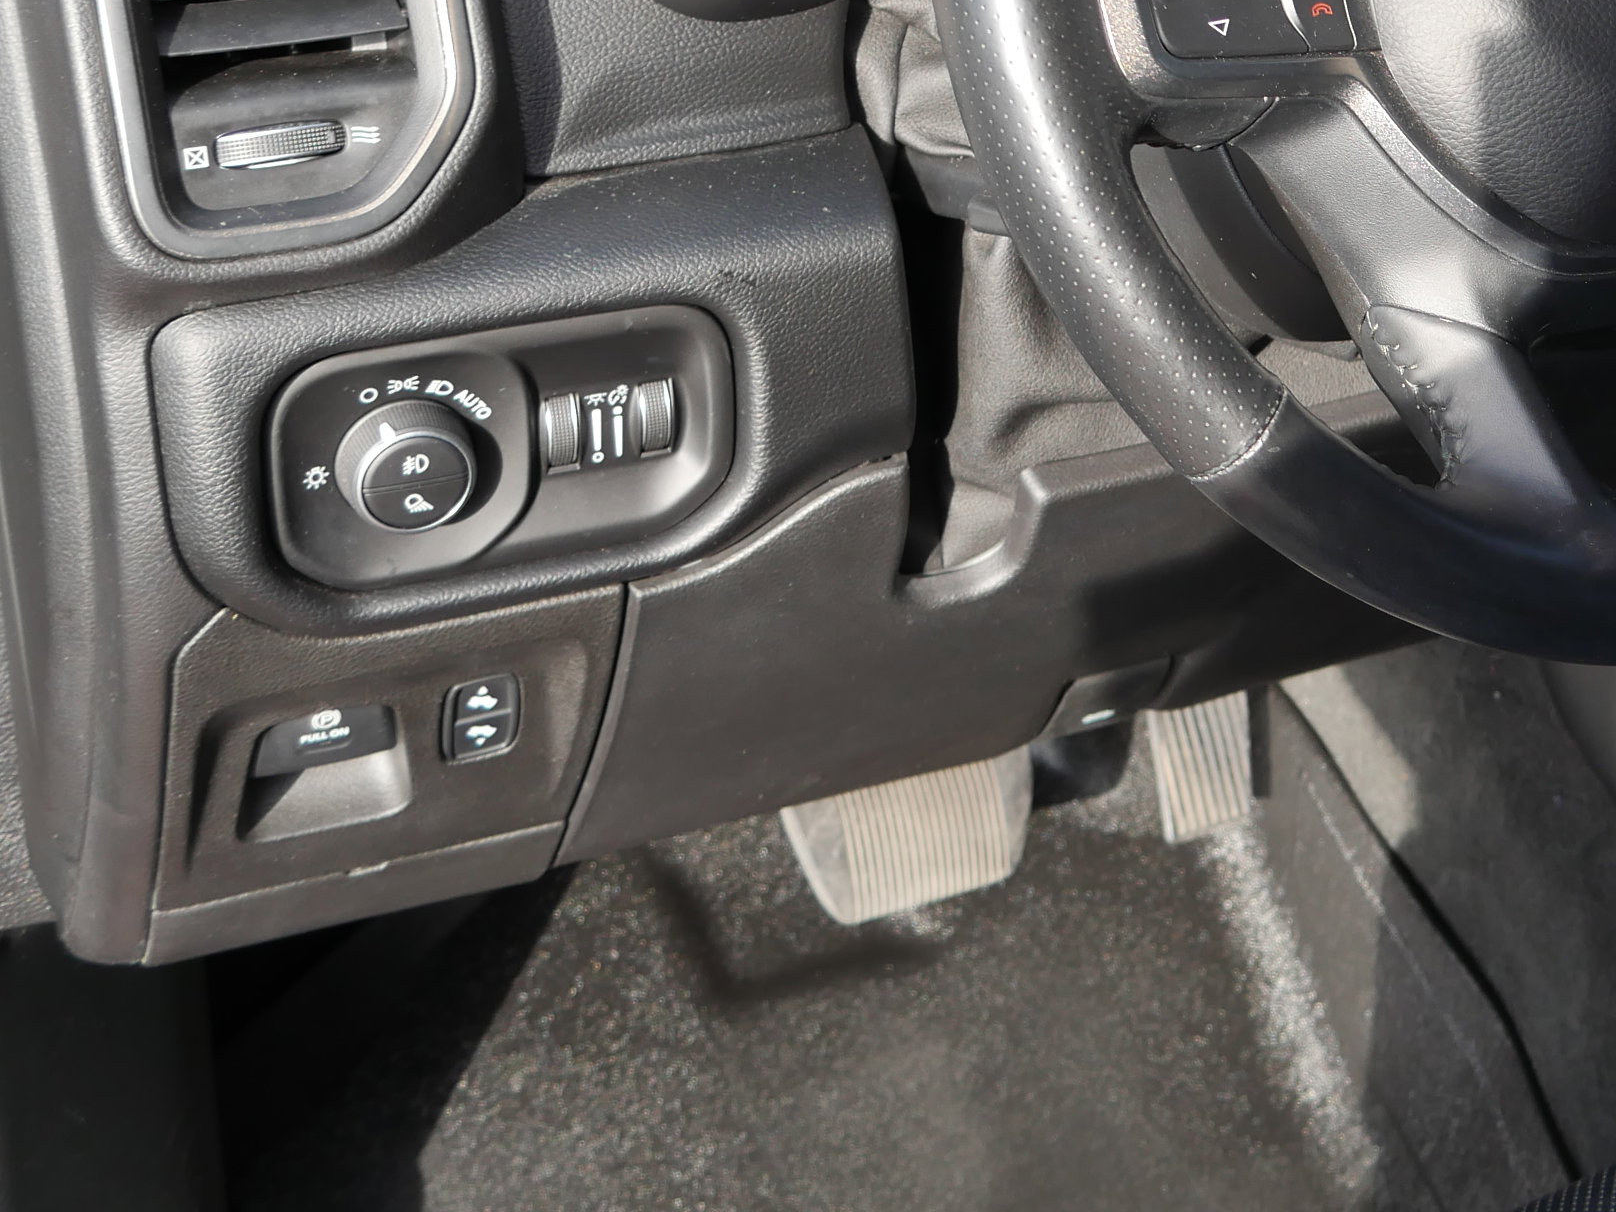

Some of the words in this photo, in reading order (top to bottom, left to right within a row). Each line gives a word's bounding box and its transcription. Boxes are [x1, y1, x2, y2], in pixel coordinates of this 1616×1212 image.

[453, 390, 493, 421] AUTO
[299, 731, 329, 745] PULL
[328, 726, 351, 739] ON
